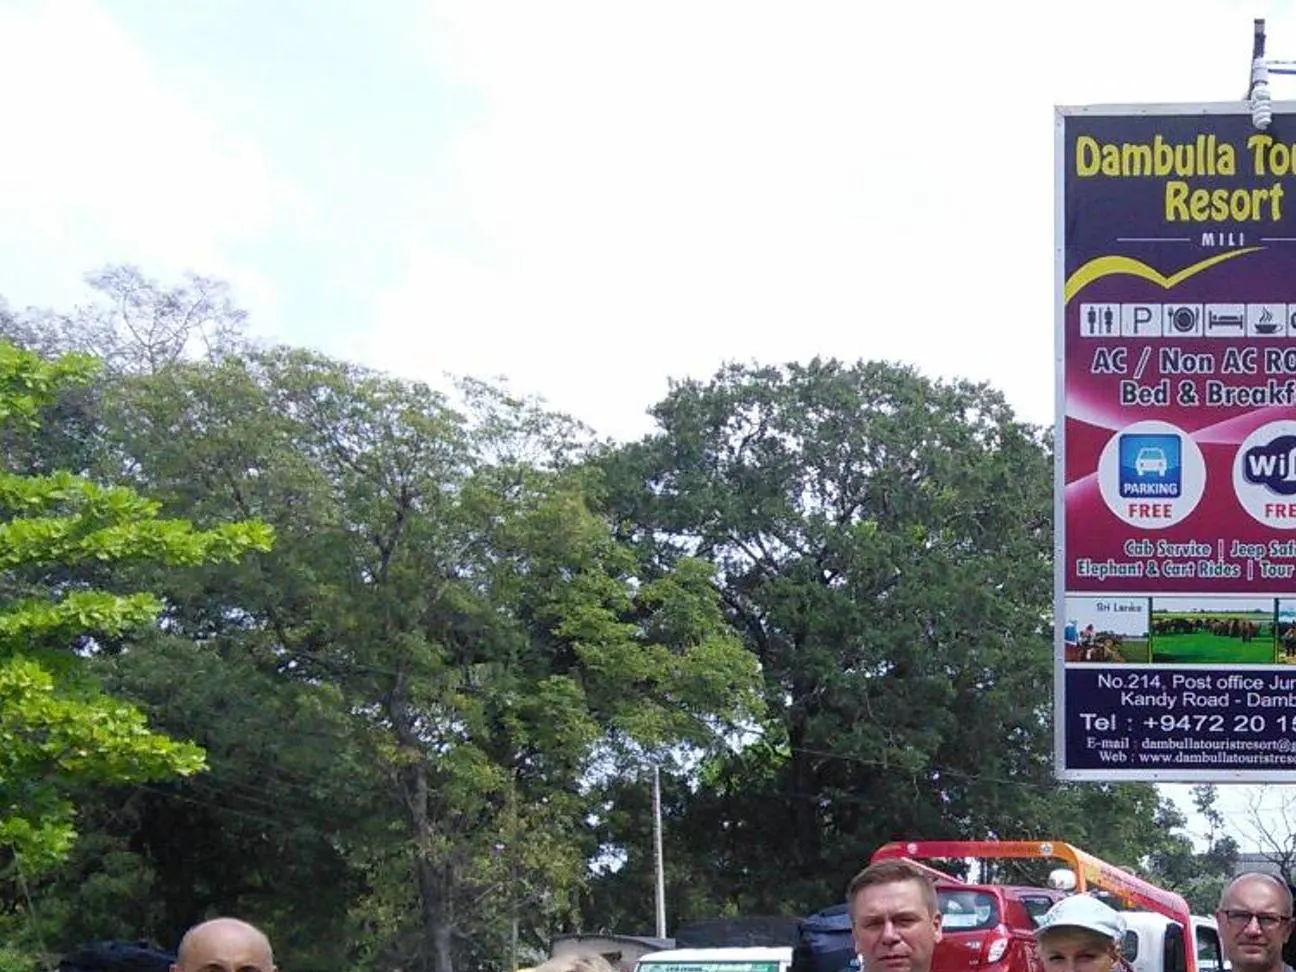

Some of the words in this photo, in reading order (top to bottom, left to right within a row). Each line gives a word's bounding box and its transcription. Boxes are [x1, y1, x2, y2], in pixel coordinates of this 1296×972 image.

[1075, 134, 1236, 177] Dambulla
[1165, 181, 1284, 221] Resort
[1202, 232, 1245, 246] MILI
[1091, 347, 1127, 374] AC
[1160, 347, 1214, 374] Non
[1221, 347, 1256, 374] AC
[1121, 379, 1169, 406] Bed
[1177, 380, 1200, 406] &
[1123, 482, 1178, 496] PARKING
[1128, 504, 1173, 518] FREE
[1124, 539, 1153, 557] Cab
[1157, 539, 1212, 557] Service
[1230, 539, 1265, 560] Jeep
[1076, 560, 1144, 581] Elephant
[1147, 560, 1160, 578] &
[1163, 560, 1196, 578] Cart
[1199, 560, 1241, 578] Rides
[1260, 560, 1294, 578] Tour
[1097, 674, 1167, 691] No.214,
[1172, 675, 1212, 690] Post
[1216, 674, 1264, 691] office
[1120, 692, 1177, 709] Kandy
[1183, 692, 1230, 707] Road
[1080, 713, 1117, 730] Tel
[1143, 715, 1225, 732] +9472
[1233, 715, 1266, 732] 20
[1087, 737, 1130, 749] E-mail
[1100, 751, 1127, 763] Web
